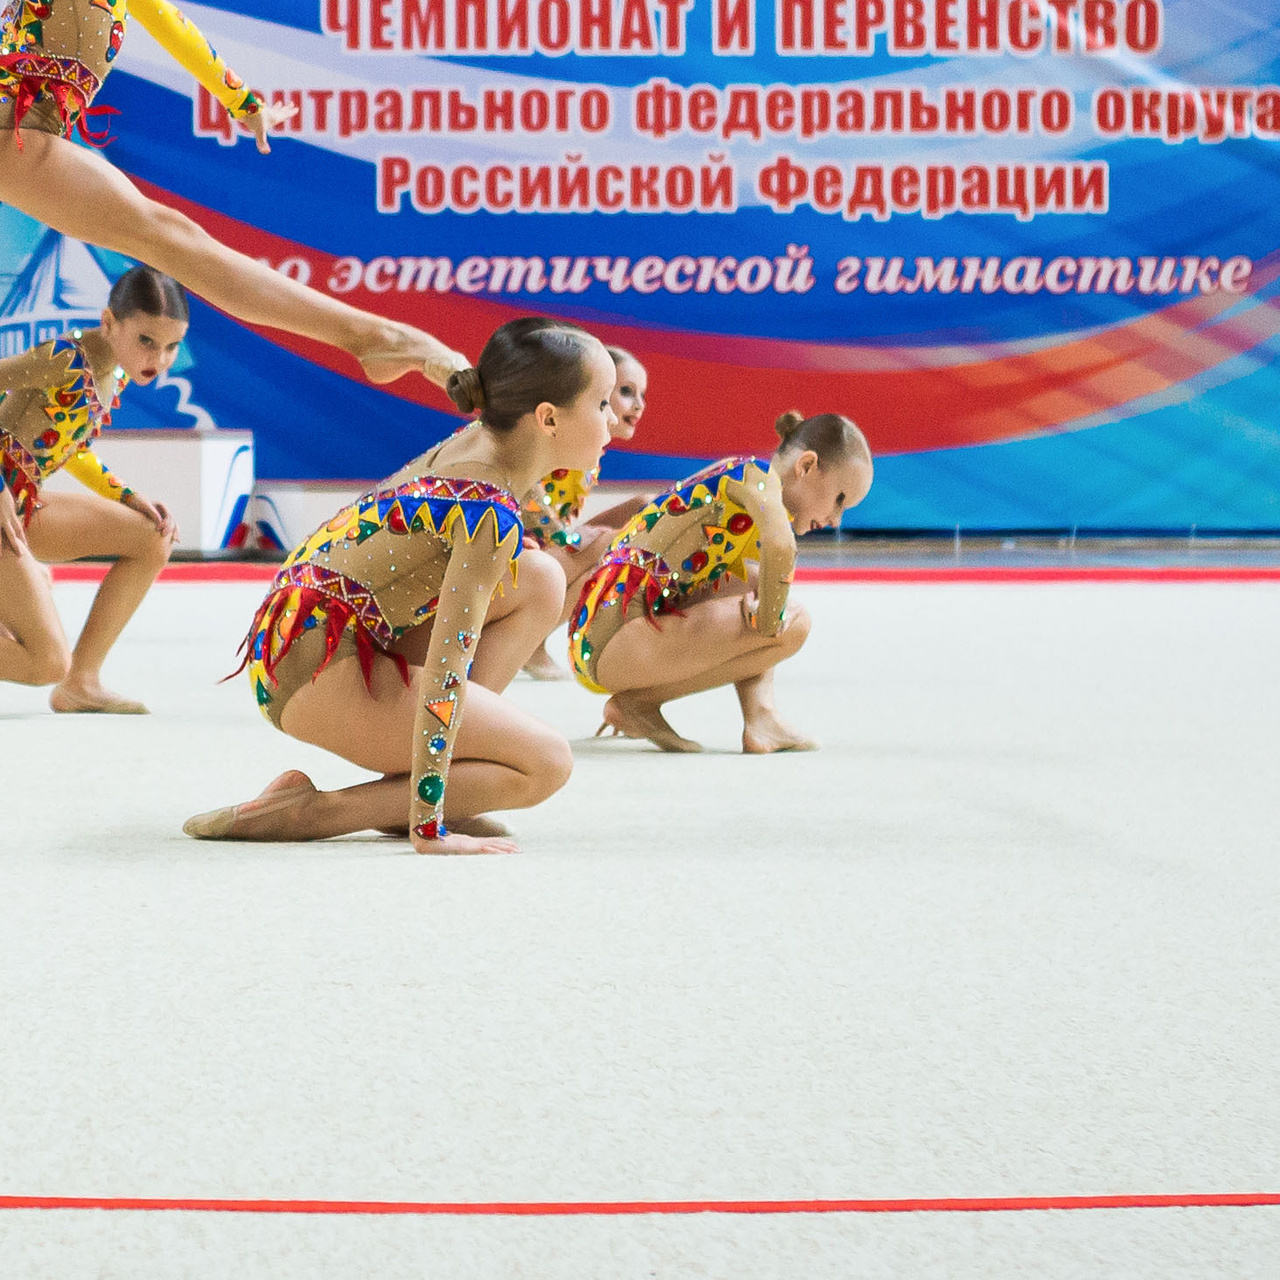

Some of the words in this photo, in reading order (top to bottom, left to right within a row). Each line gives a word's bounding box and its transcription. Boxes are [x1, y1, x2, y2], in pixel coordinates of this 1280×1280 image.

[635, 84, 1071, 138] федерального
[1096, 88, 1280, 138] округа
[380, 154, 733, 210] Российской
[759, 157, 1106, 217] Федерации
[326, 244, 816, 296] эстетической
[835, 254, 1252, 295] гимнастике
